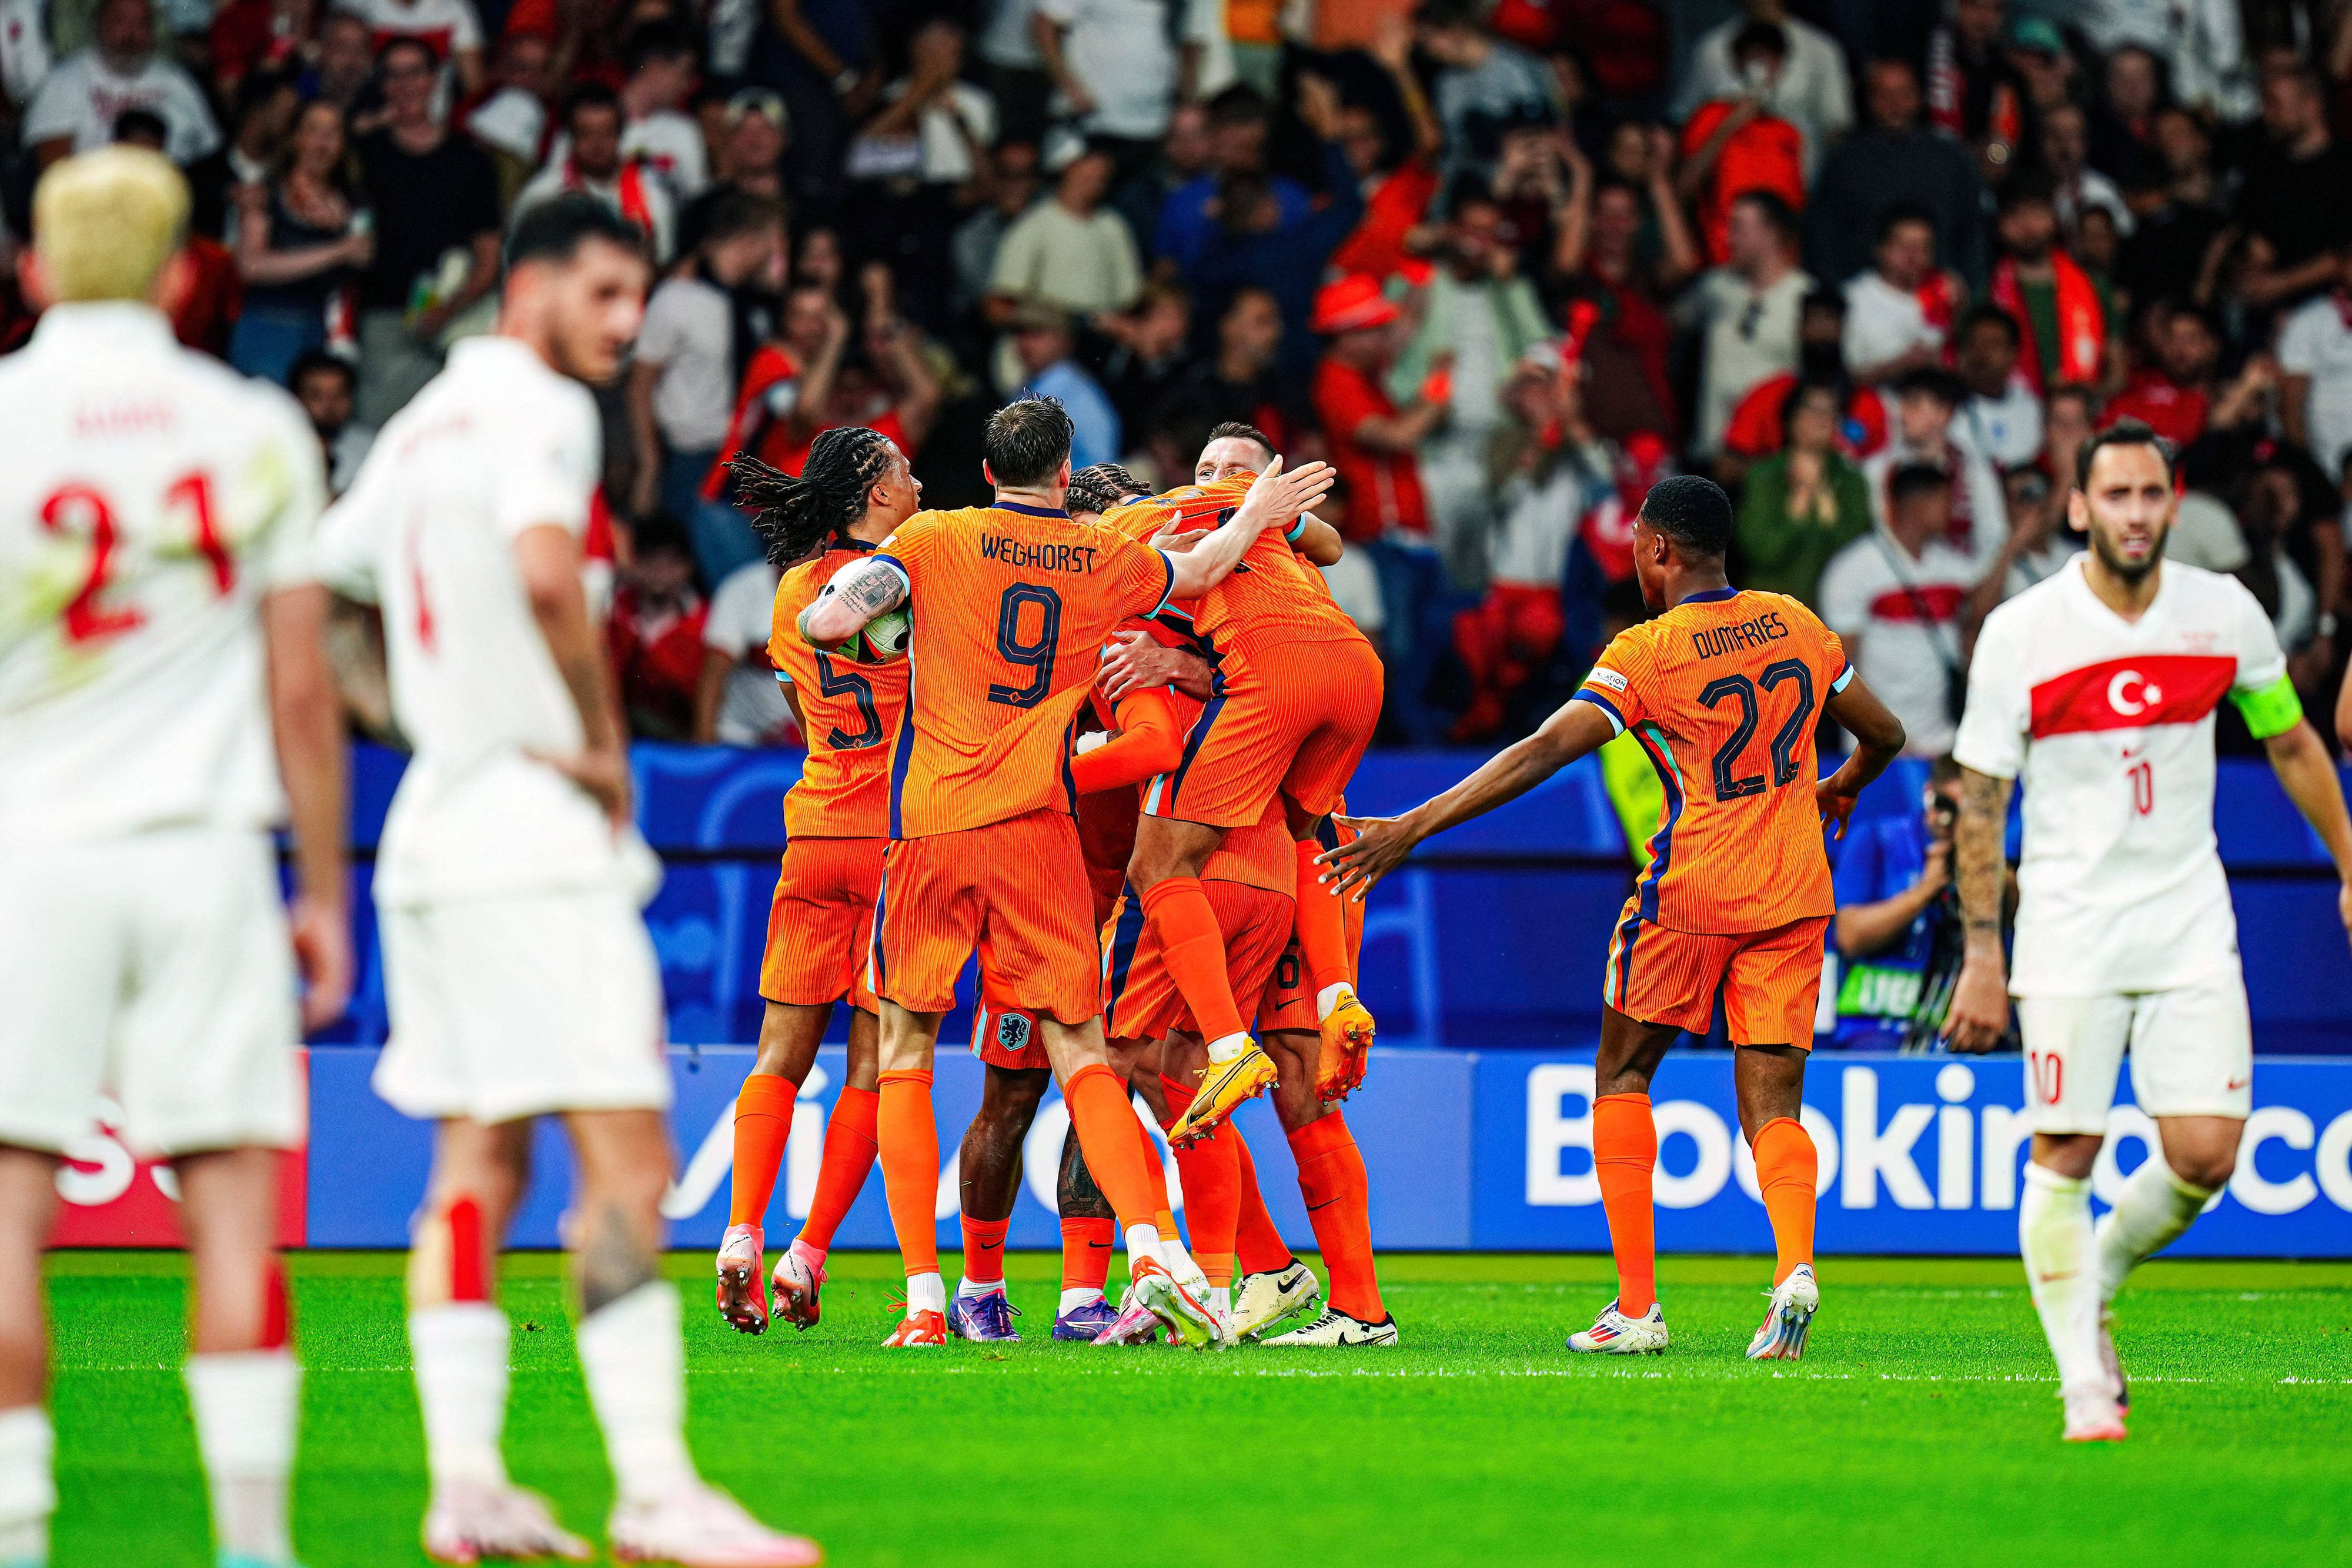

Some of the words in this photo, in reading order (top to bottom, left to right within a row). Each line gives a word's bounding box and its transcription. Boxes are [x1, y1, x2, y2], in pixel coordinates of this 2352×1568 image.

[38, 470, 238, 647] 21
[981, 533, 1097, 574] WEGHORST
[988, 581, 1063, 709] 9
[1692, 612, 1789, 660] DUMFRIES
[814, 648, 884, 750] 5
[1697, 657, 1815, 802] 22
[2126, 762, 2153, 815] 10
[2032, 1051, 2062, 1105] 10
